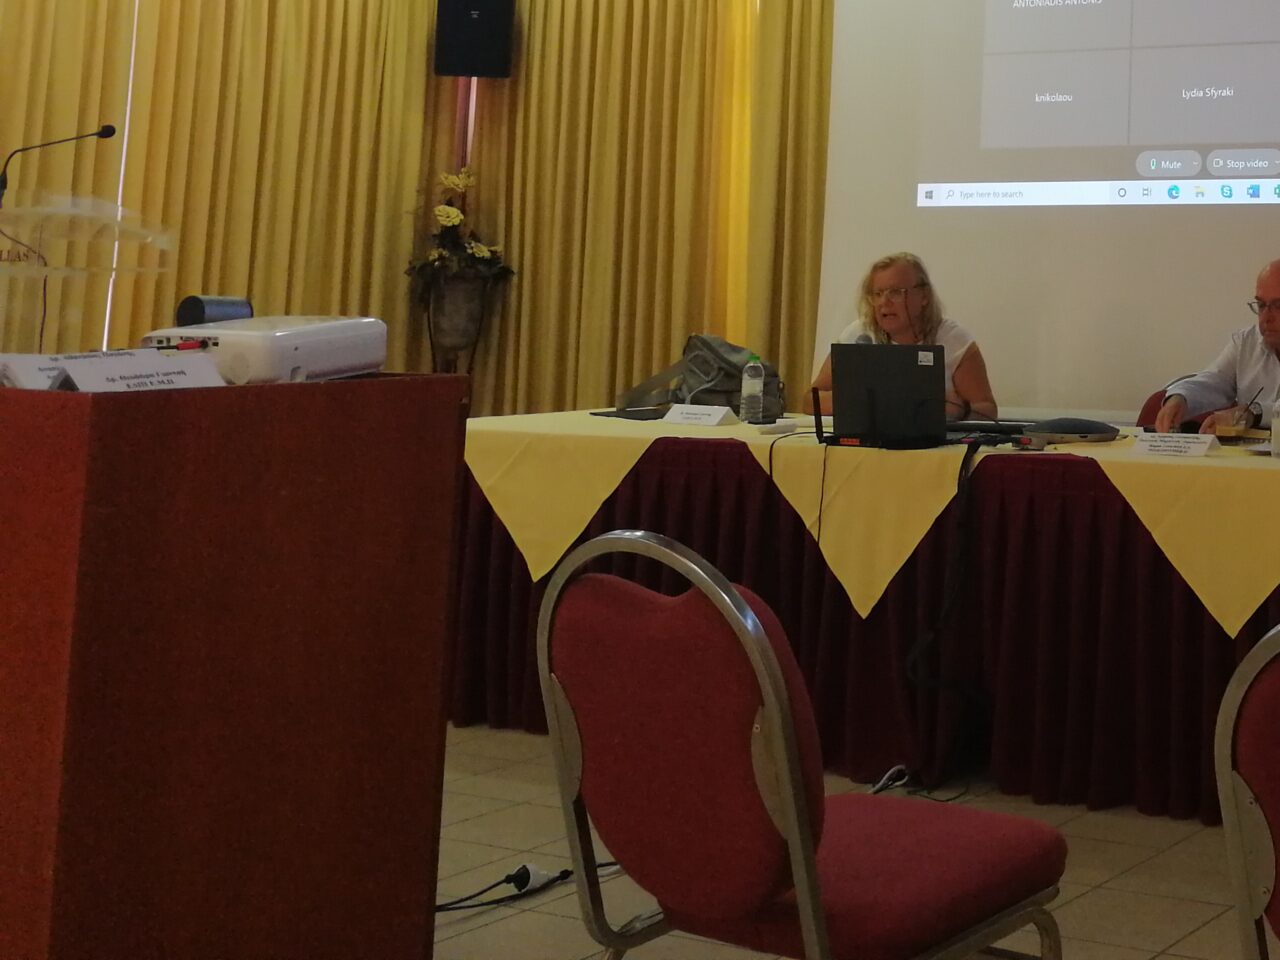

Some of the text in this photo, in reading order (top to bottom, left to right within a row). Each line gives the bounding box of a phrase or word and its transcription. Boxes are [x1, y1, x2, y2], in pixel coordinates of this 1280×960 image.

[1035, 92, 1073, 102] knikolaou
[1182, 86, 1234, 99] Lydia Sfyraki
[1161, 159, 1182, 169] Mute
[1227, 157, 1269, 169] Stop video
[959, 190, 1023, 200] Type here to search
